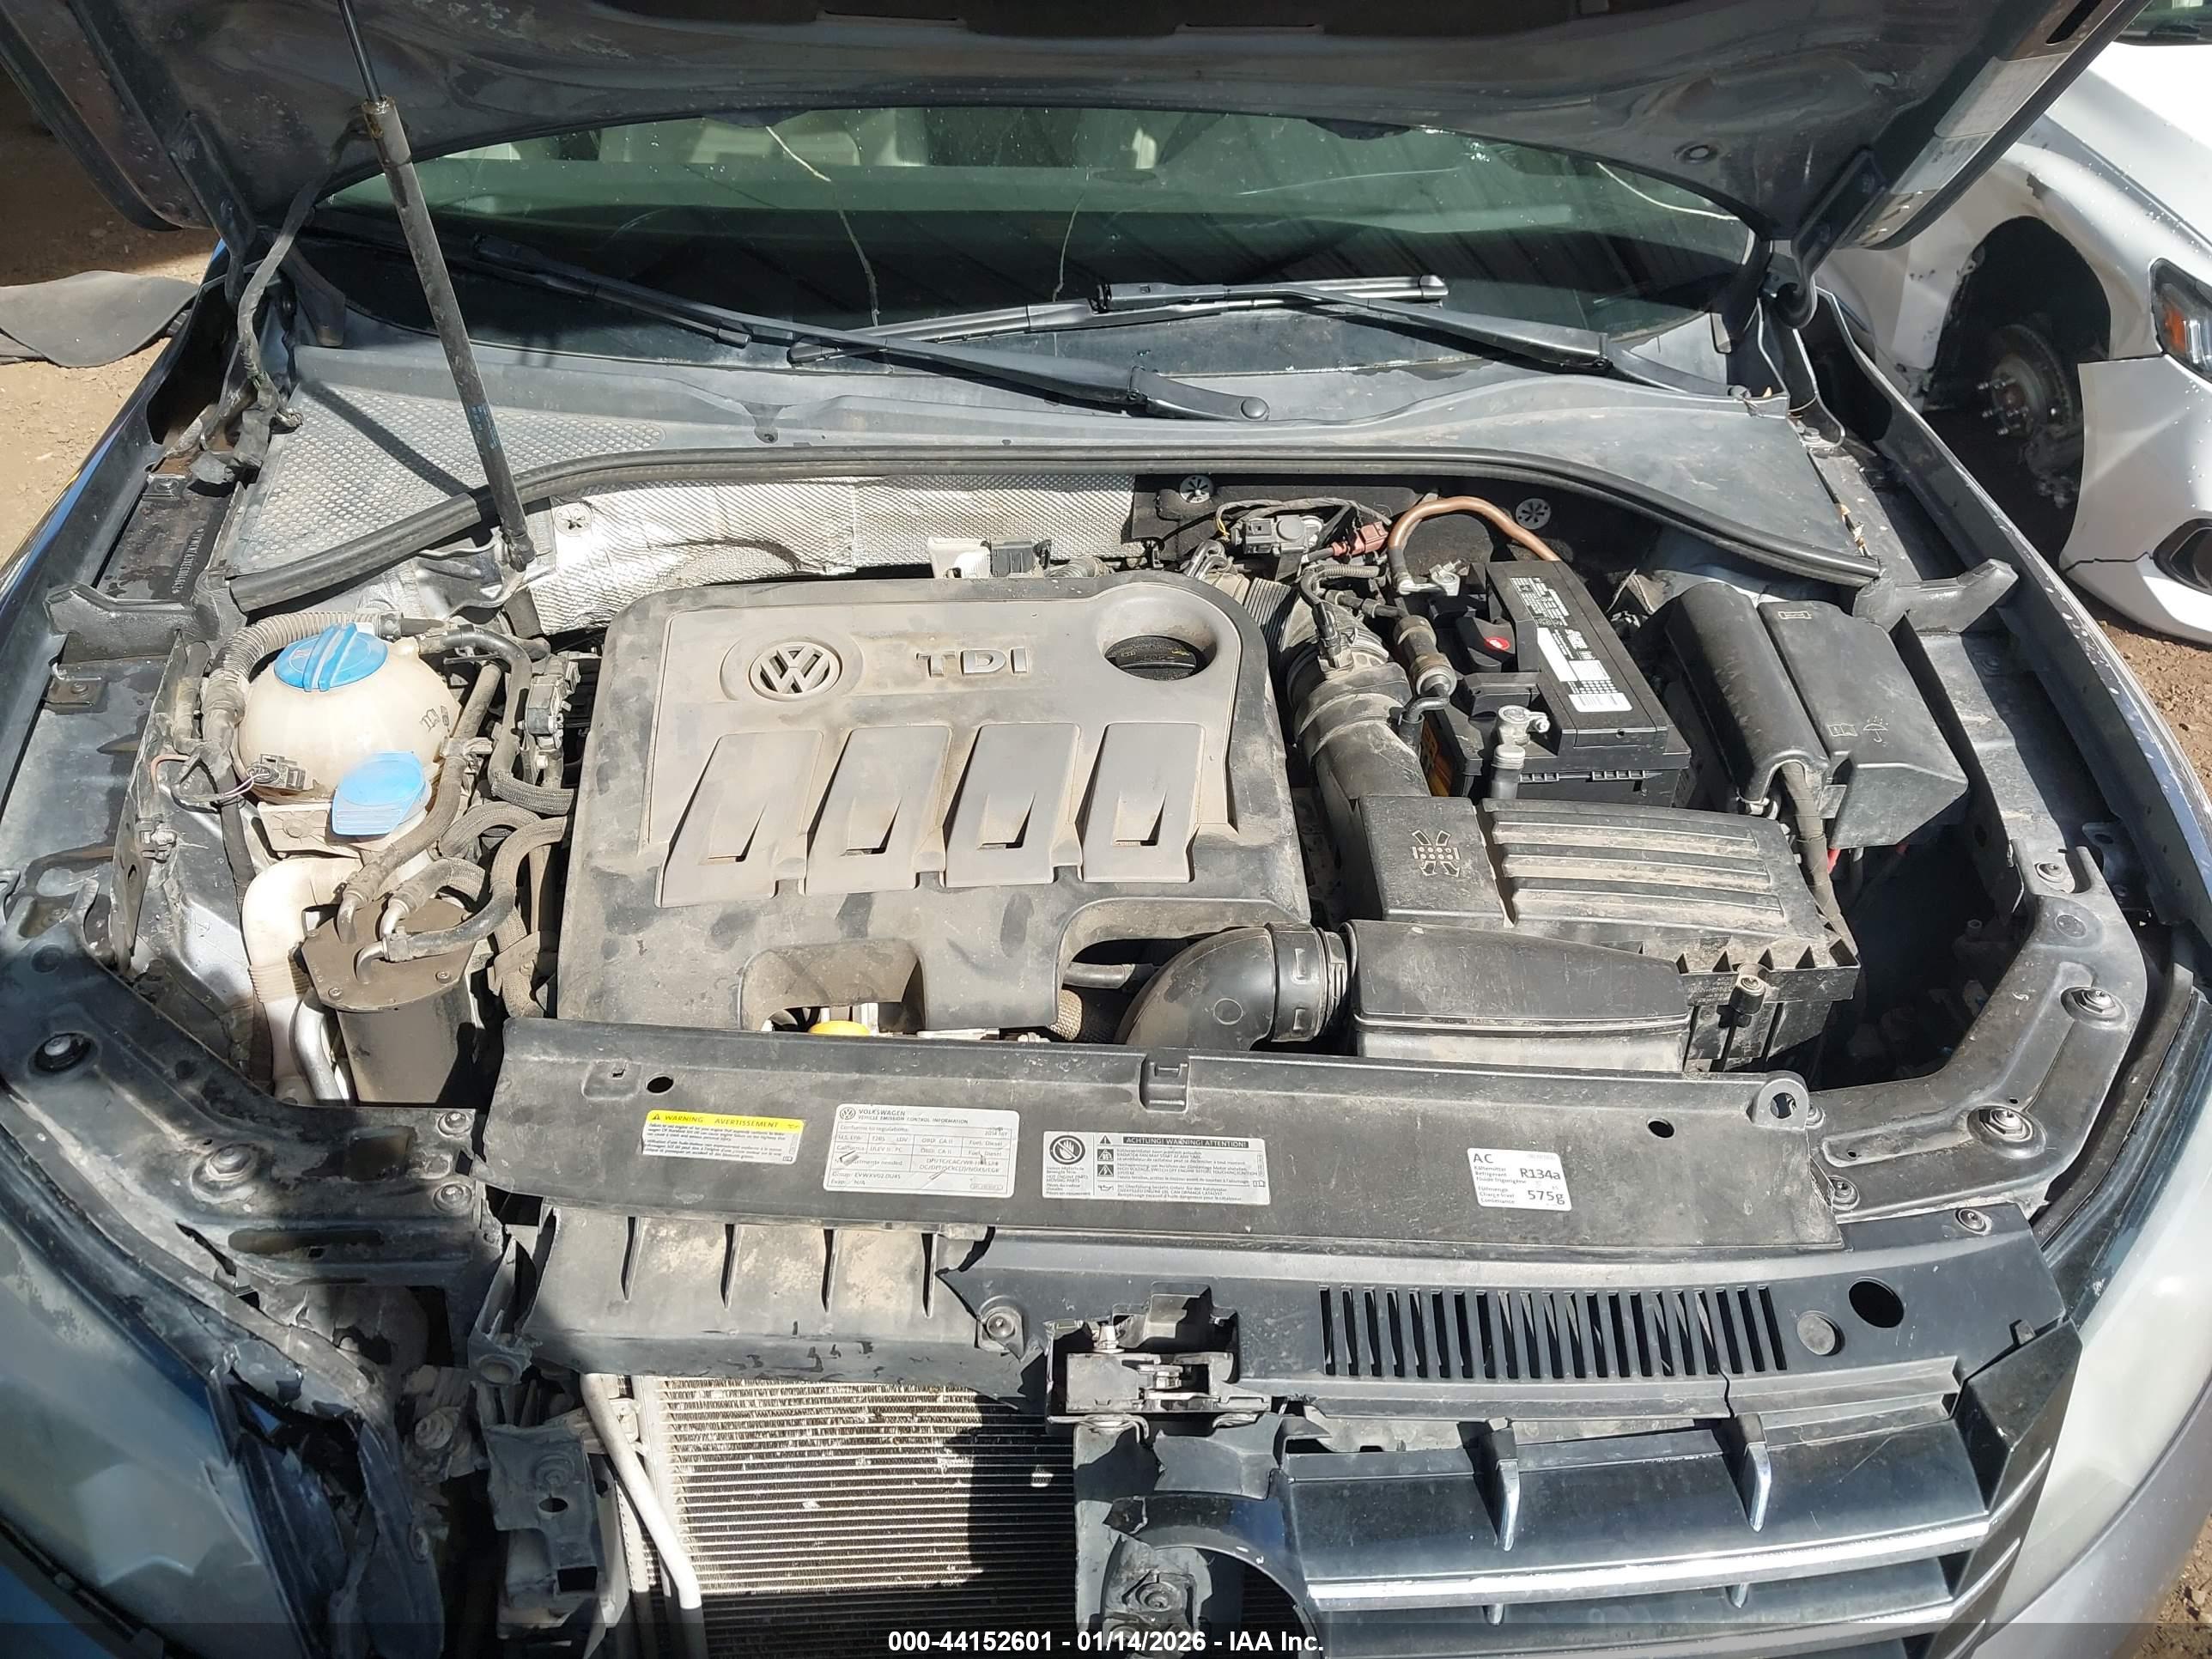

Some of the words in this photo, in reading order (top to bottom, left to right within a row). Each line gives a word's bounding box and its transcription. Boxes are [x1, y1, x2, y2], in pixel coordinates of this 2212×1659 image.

[915, 647, 1030, 678] TDI
[665, 1115, 703, 1123] WARNING
[714, 1118, 779, 1127] AVERTISSEMENT
[1519, 1167, 1562, 1181] R134a
[1527, 1189, 1565, 1206] 575g
